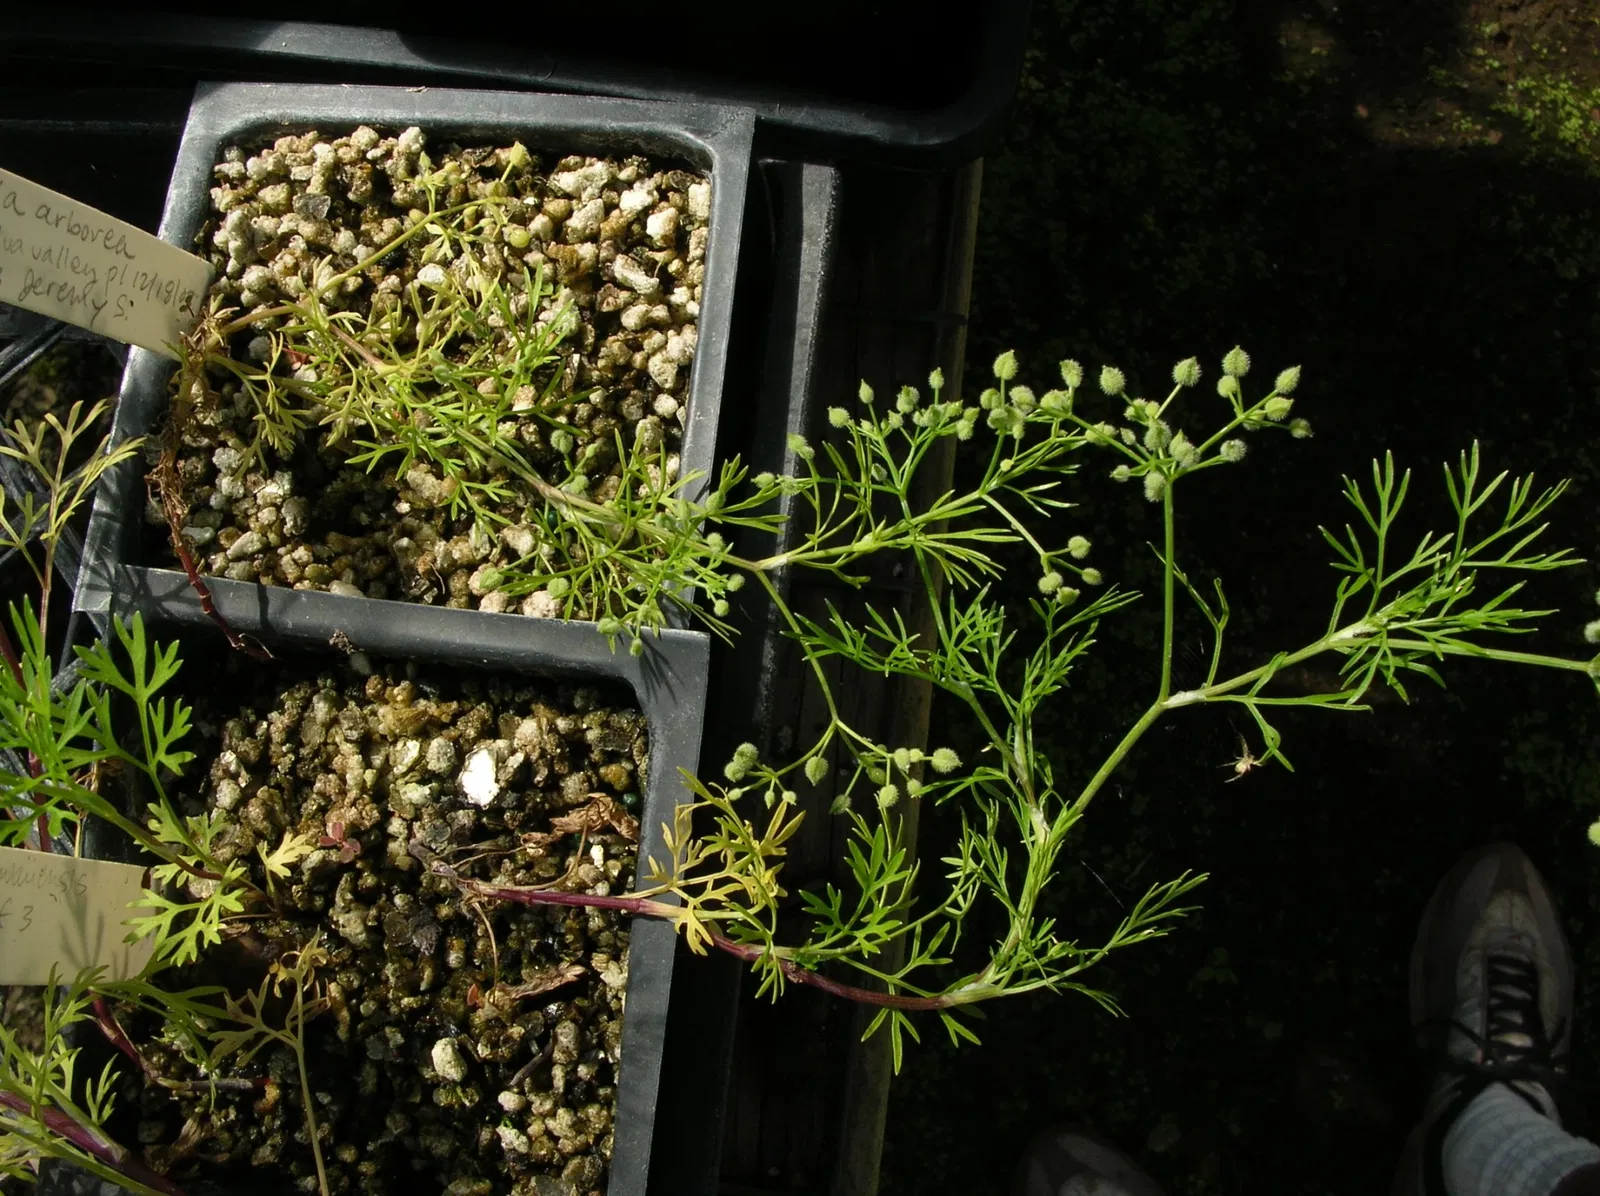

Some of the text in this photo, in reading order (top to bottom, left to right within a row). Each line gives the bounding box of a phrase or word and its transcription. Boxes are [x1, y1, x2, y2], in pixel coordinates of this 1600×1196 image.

[35, 203, 135, 260] arborea
[32, 244, 98, 293] valley
[18, 905, 34, 932] 3
